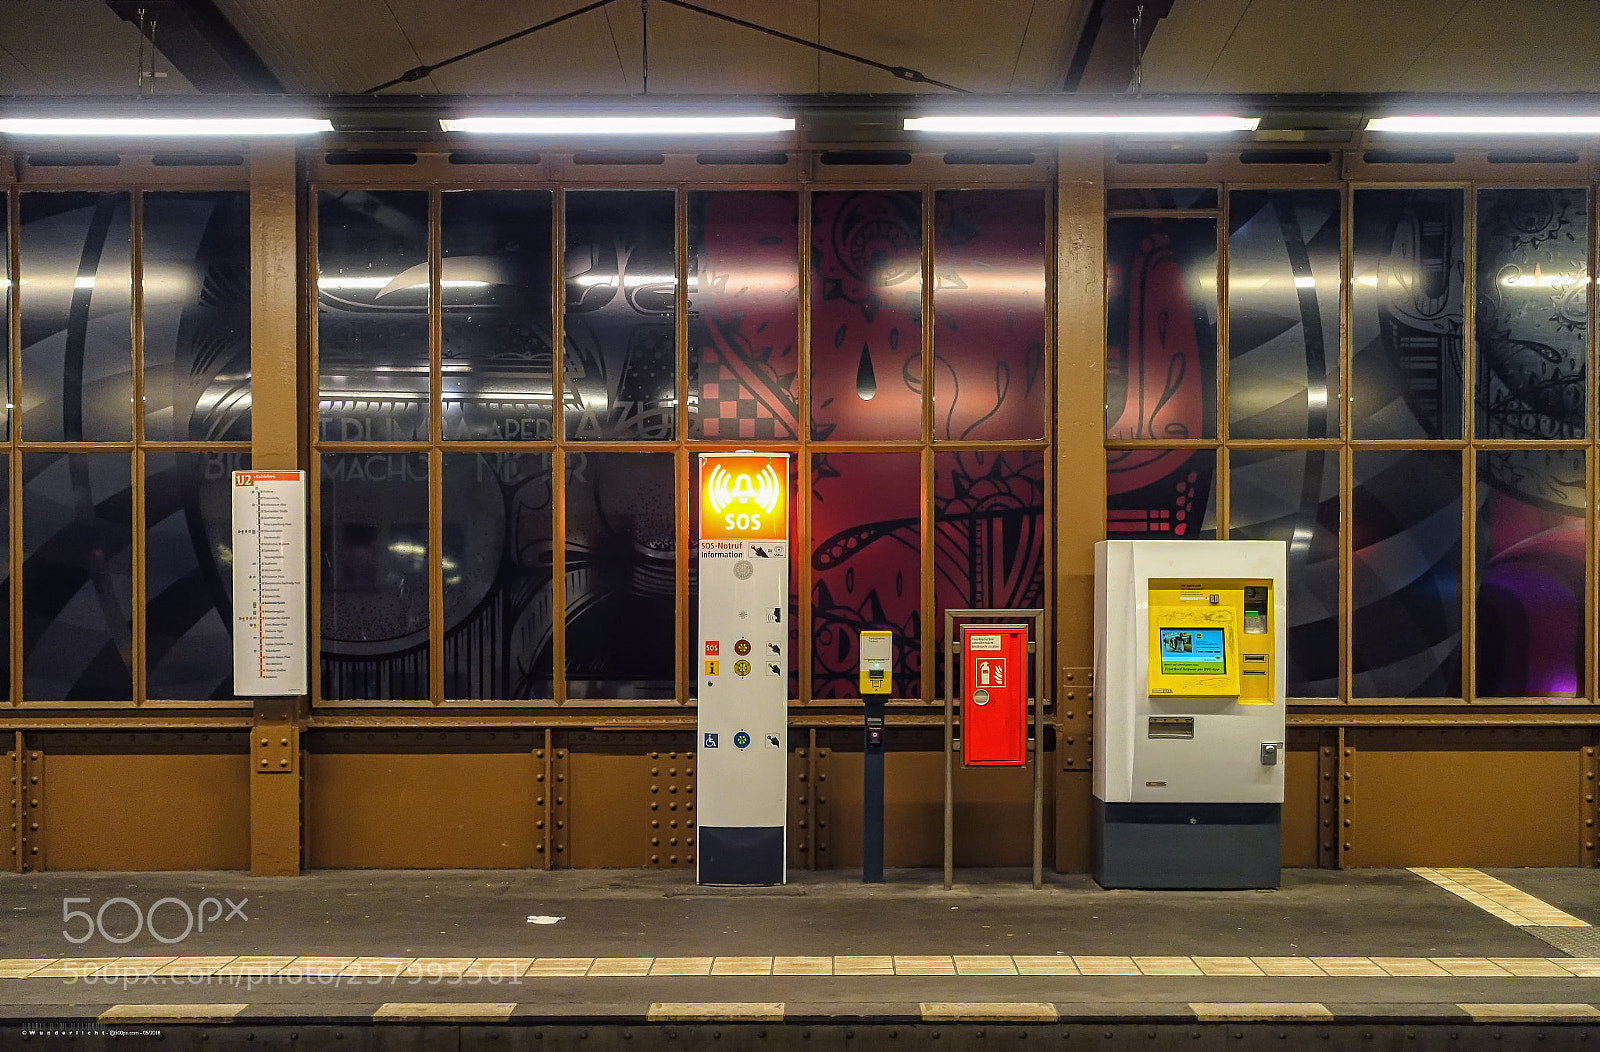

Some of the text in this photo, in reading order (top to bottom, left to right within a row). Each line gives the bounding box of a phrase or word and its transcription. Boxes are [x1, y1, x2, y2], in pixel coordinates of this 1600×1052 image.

[237, 474, 252, 486] U2
[725, 513, 761, 531] SOS
[701, 541, 743, 550] SOS-Notruf
[701, 550, 743, 559] Information
